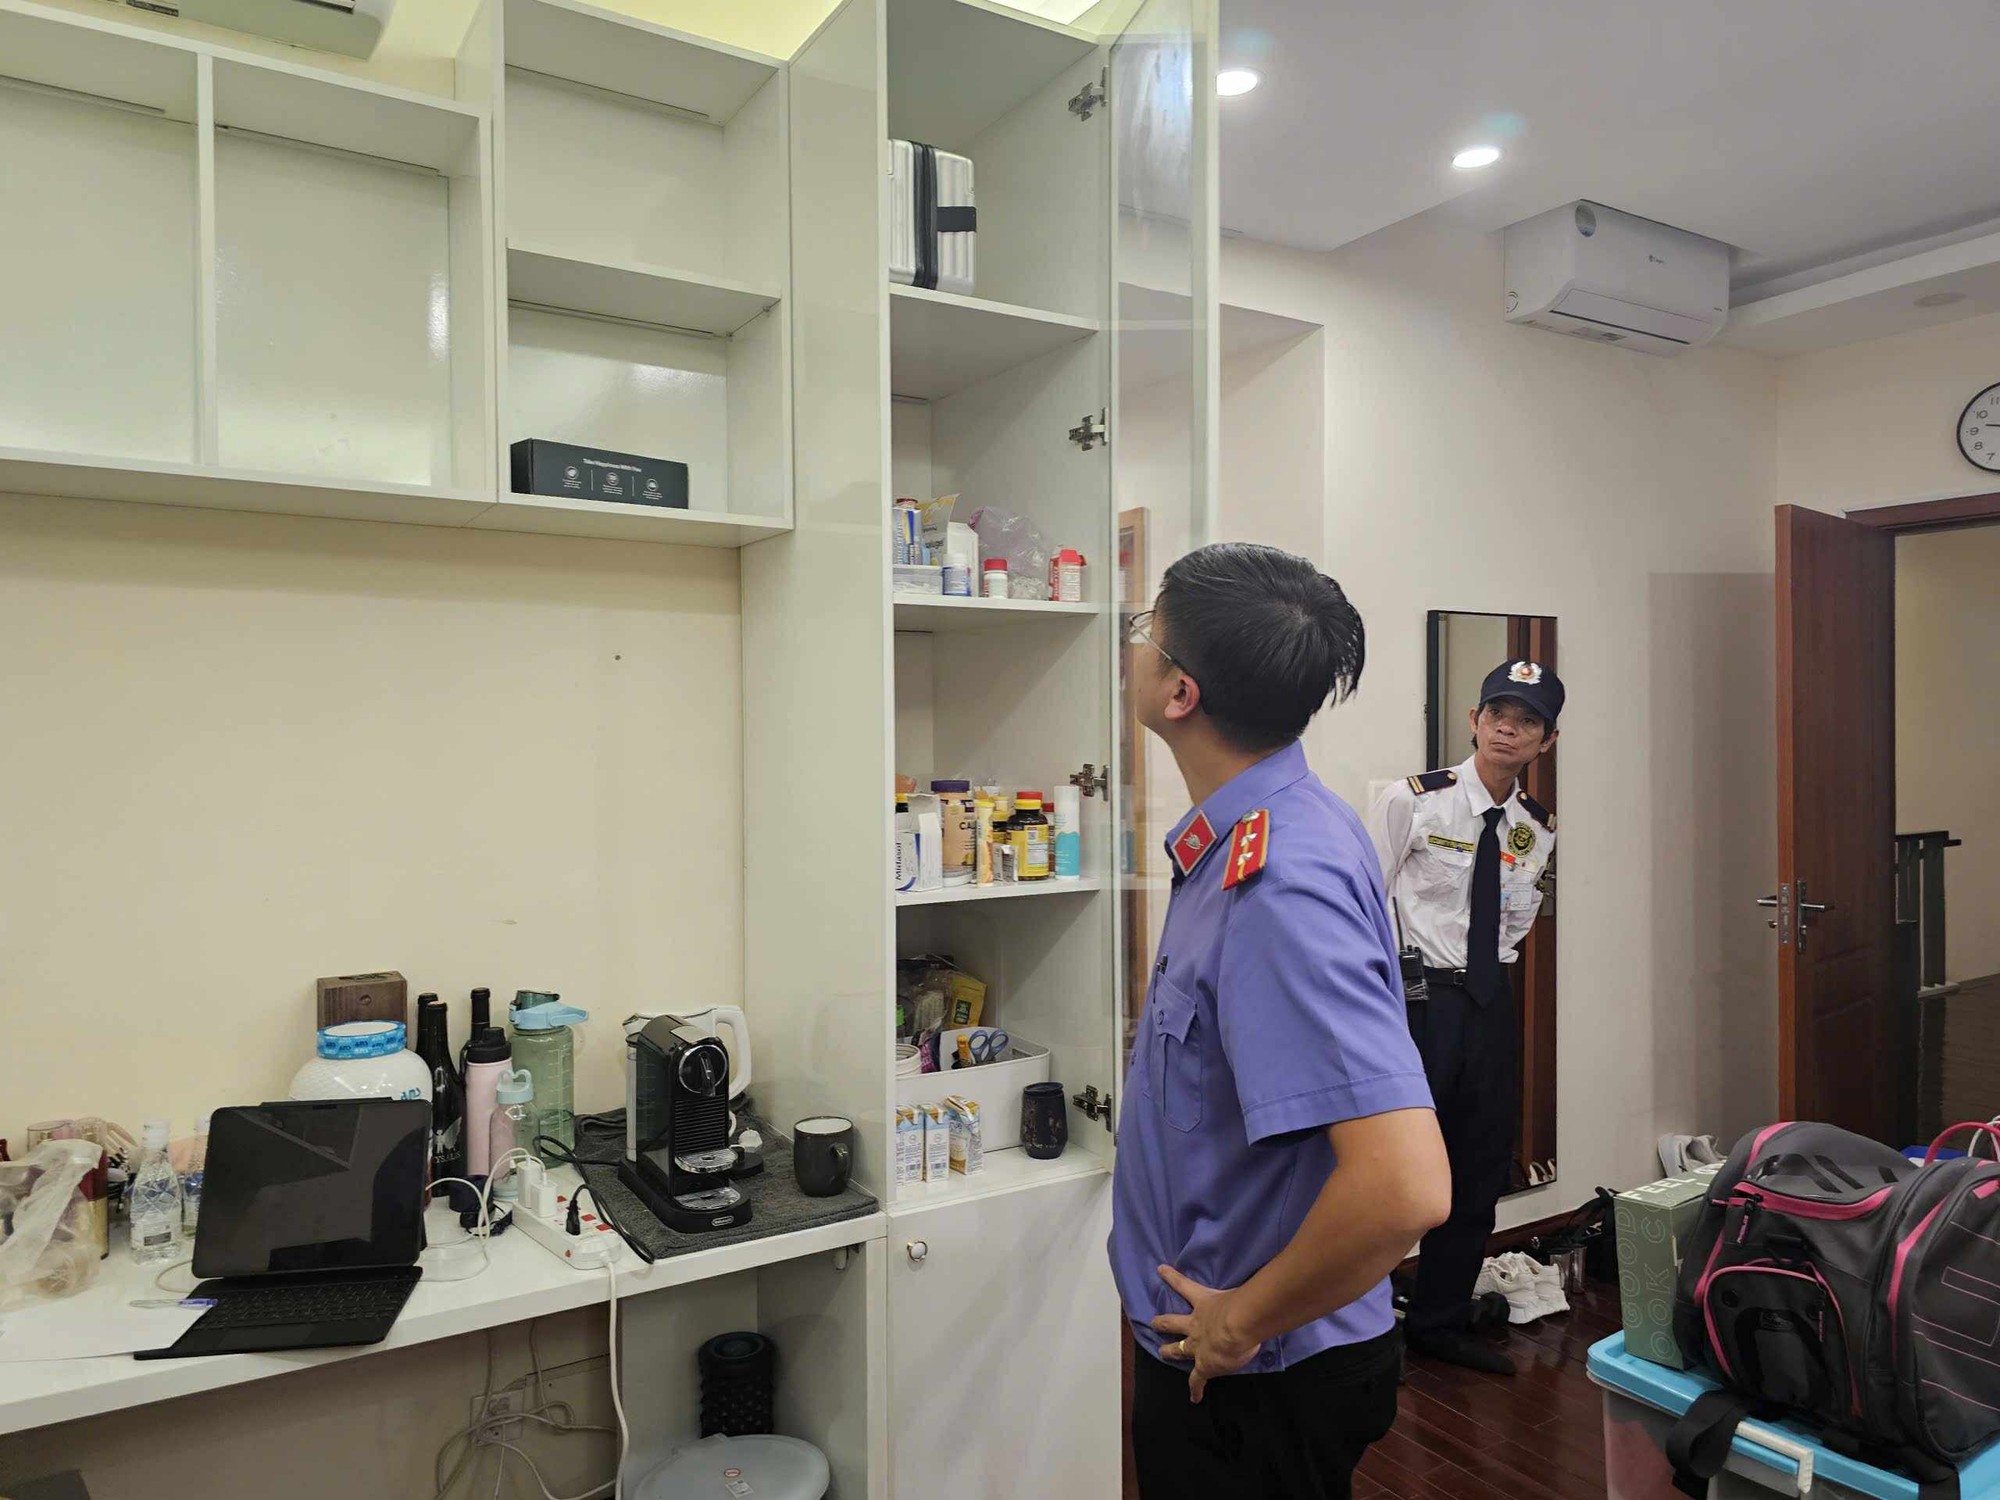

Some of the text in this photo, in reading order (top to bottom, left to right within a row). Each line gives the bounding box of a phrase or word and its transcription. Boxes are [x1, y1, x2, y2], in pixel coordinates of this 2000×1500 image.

[1976, 410, 1988, 419] 10
[1970, 427, 1979, 436] 9
[1974, 441, 1983, 450] 8
[1987, 452, 1995, 461] 7
[1616, 1177, 1698, 1201] FEEL
[1615, 1206, 1643, 1329] GOOD
